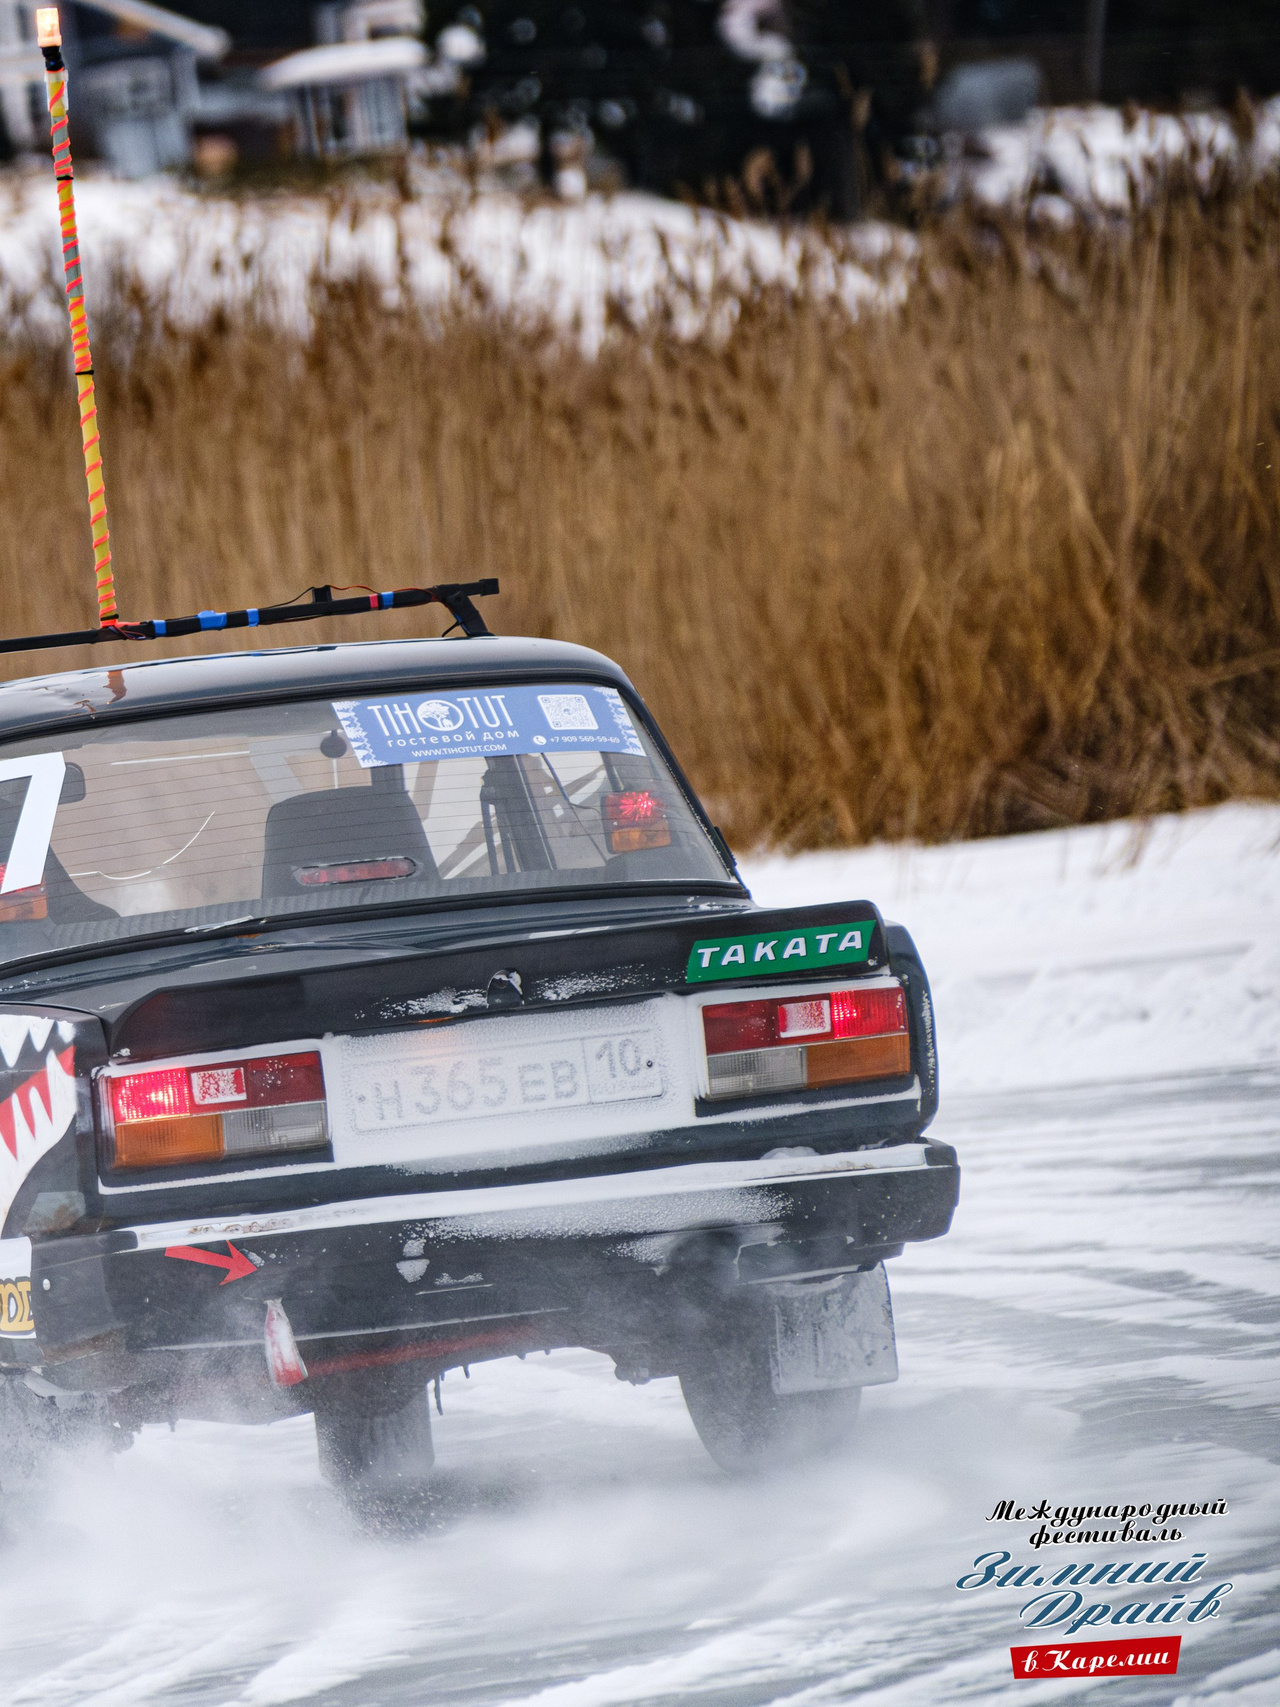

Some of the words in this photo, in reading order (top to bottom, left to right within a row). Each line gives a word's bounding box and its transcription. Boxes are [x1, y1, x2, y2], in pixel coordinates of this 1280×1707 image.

[367, 695, 514, 737] TIHOTUT
[387, 730, 476, 748] гостевой
[483, 730, 520, 742] дом
[411, 743, 508, 757] WWW.TIHOTUT.COM
[561, 735, 577, 743] 909
[697, 930, 864, 969] TAKATA
[595, 1038, 641, 1079] 10
